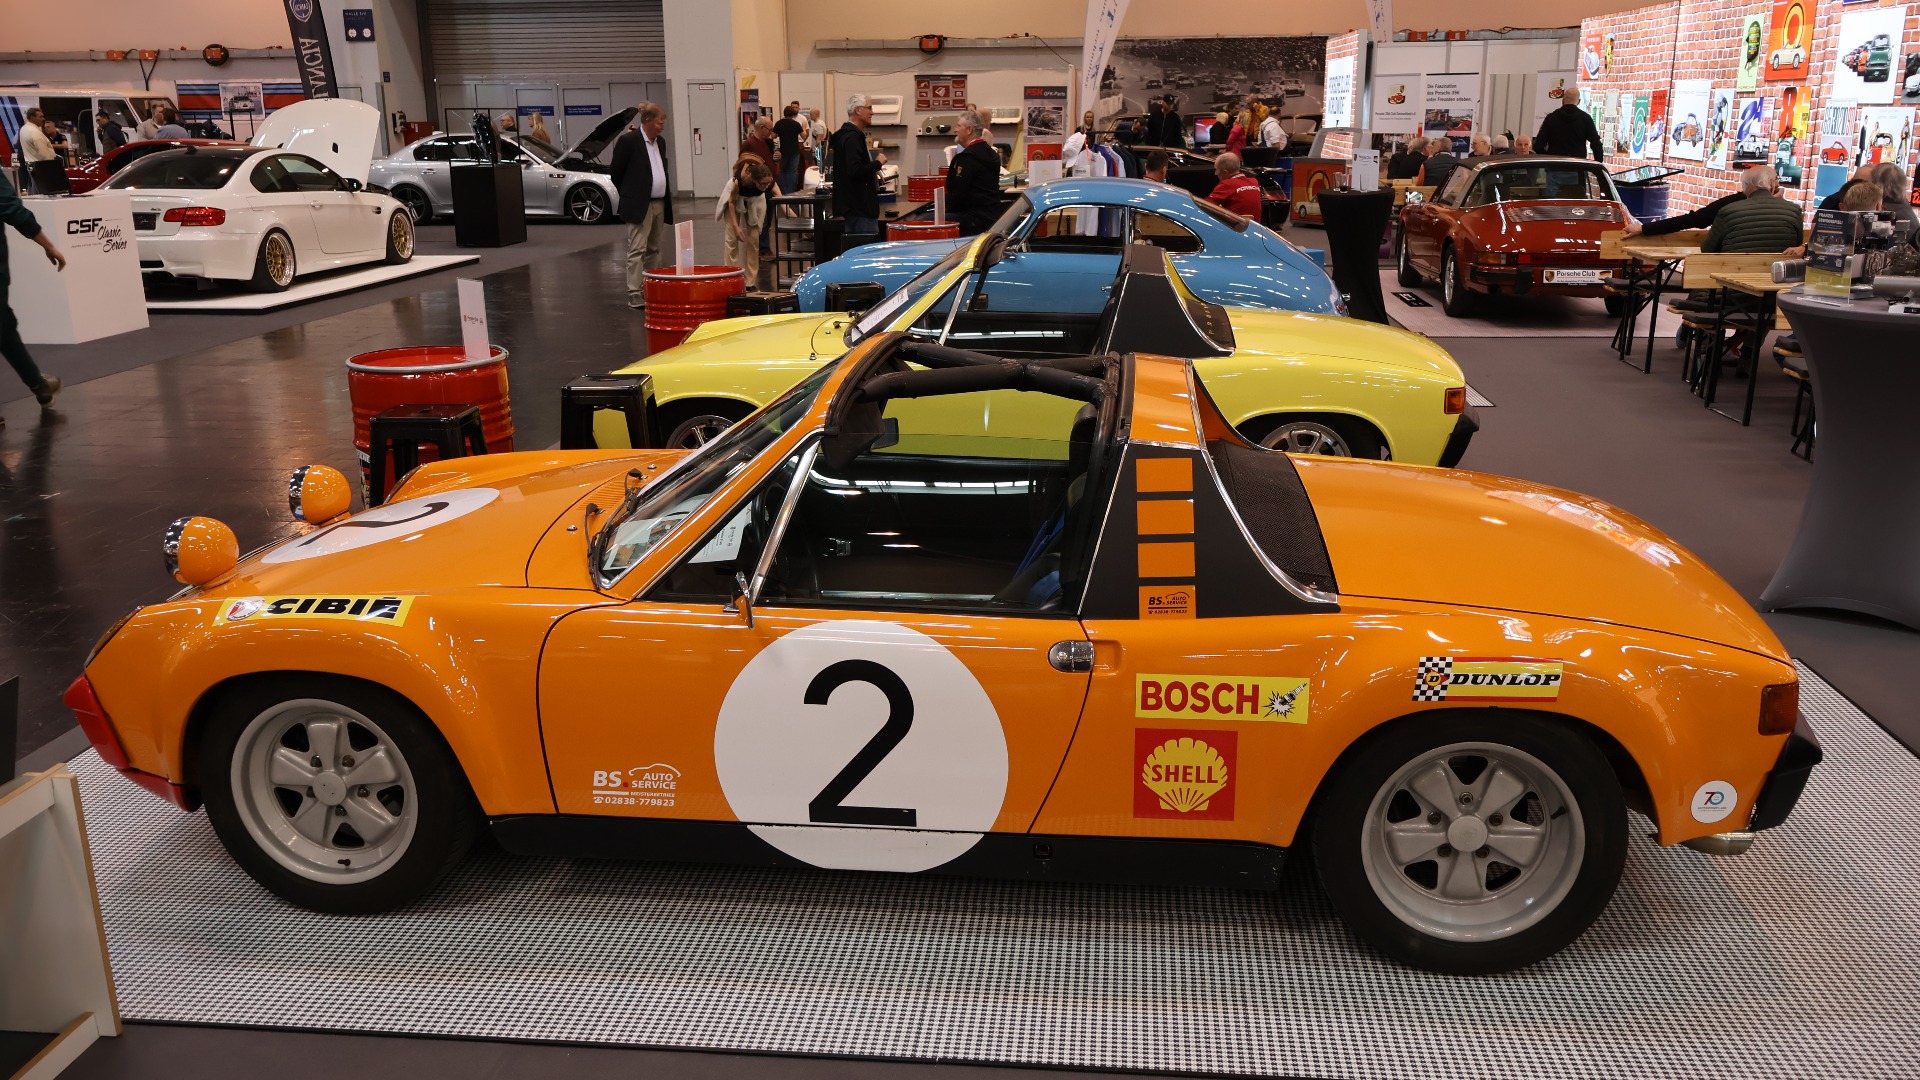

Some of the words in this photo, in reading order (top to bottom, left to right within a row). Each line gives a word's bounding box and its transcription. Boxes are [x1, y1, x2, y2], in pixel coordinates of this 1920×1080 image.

[67, 217, 103, 235] CSF
[97, 225, 121, 240] Classic
[103, 238, 127, 253] Series
[1449, 673, 1561, 686] DUNLOP
[1140, 680, 1260, 715] BOSCH
[803, 659, 917, 827] 2
[642, 772, 674, 781] AUTO
[1151, 764, 1219, 784] SHELL
[1703, 790, 1725, 806] 70
